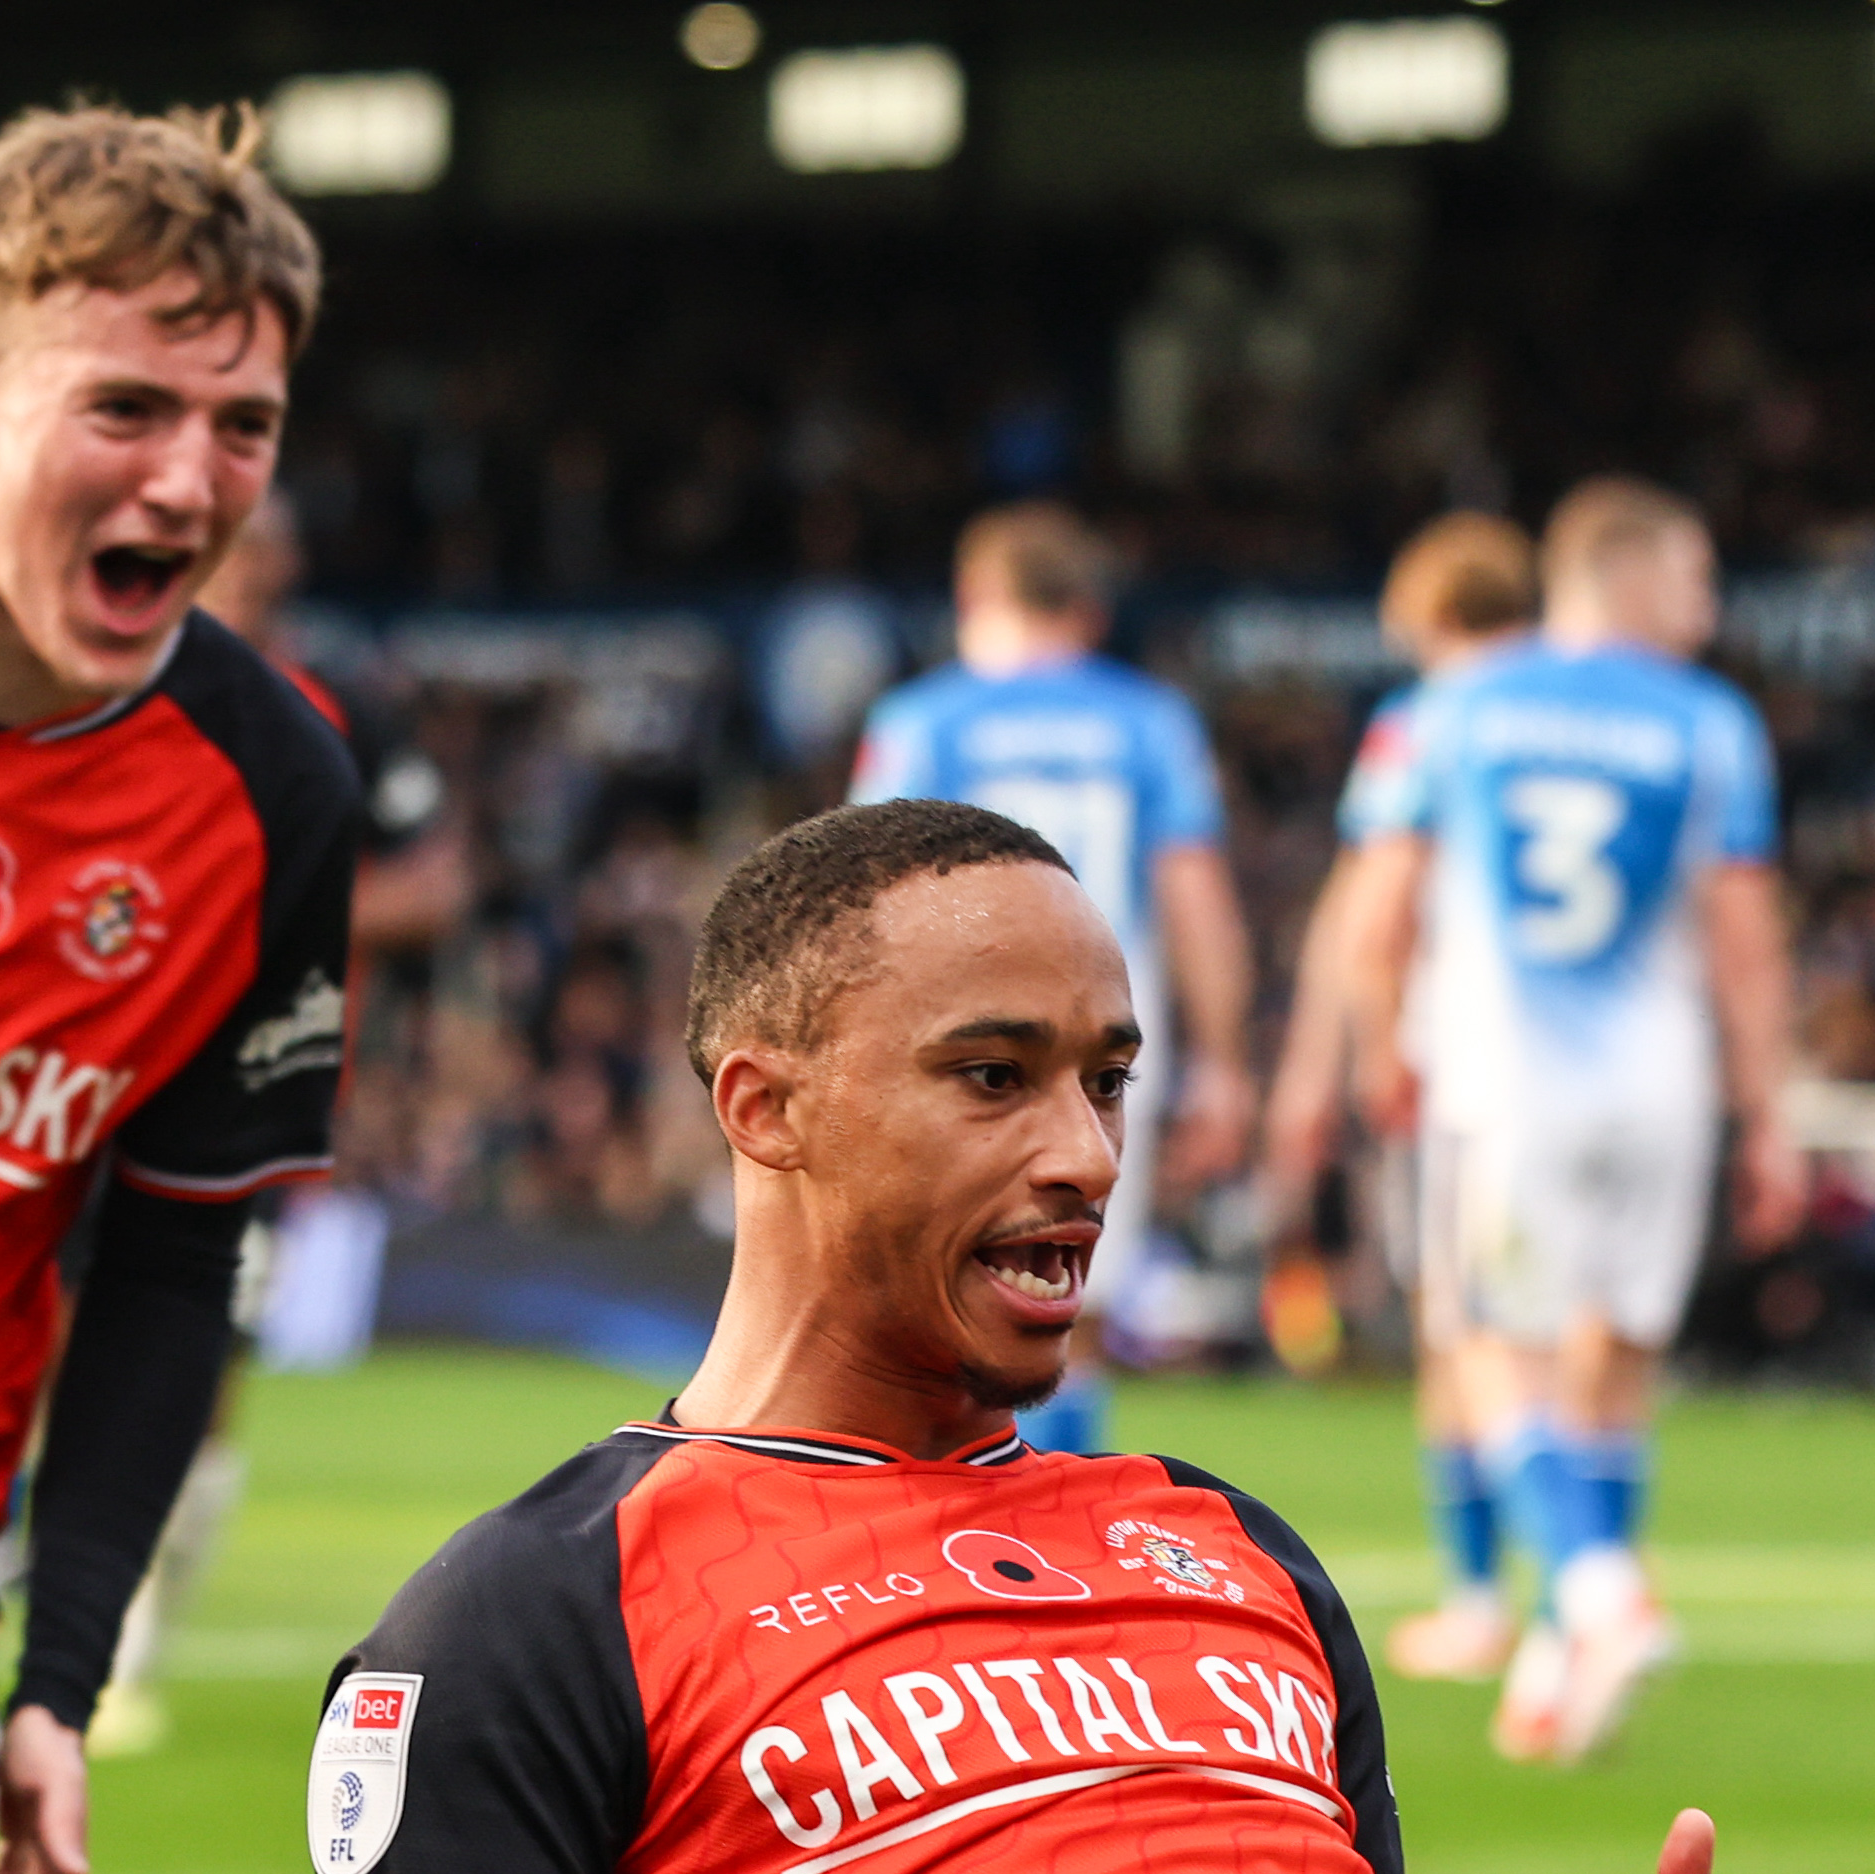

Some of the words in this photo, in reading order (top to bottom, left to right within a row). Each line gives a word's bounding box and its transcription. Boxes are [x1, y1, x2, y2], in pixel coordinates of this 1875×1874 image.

[1503, 775, 1626, 959] 3
[1105, 1519, 1141, 1549] LUTON
[748, 1572, 925, 1634] REFLO
[356, 1692, 398, 1720] bet
[365, 1735, 396, 1754] ONE
[739, 1656, 1208, 1849] CAPITAL
[1194, 1655, 1334, 1787] SKY
[330, 1838, 355, 1861] EFL
